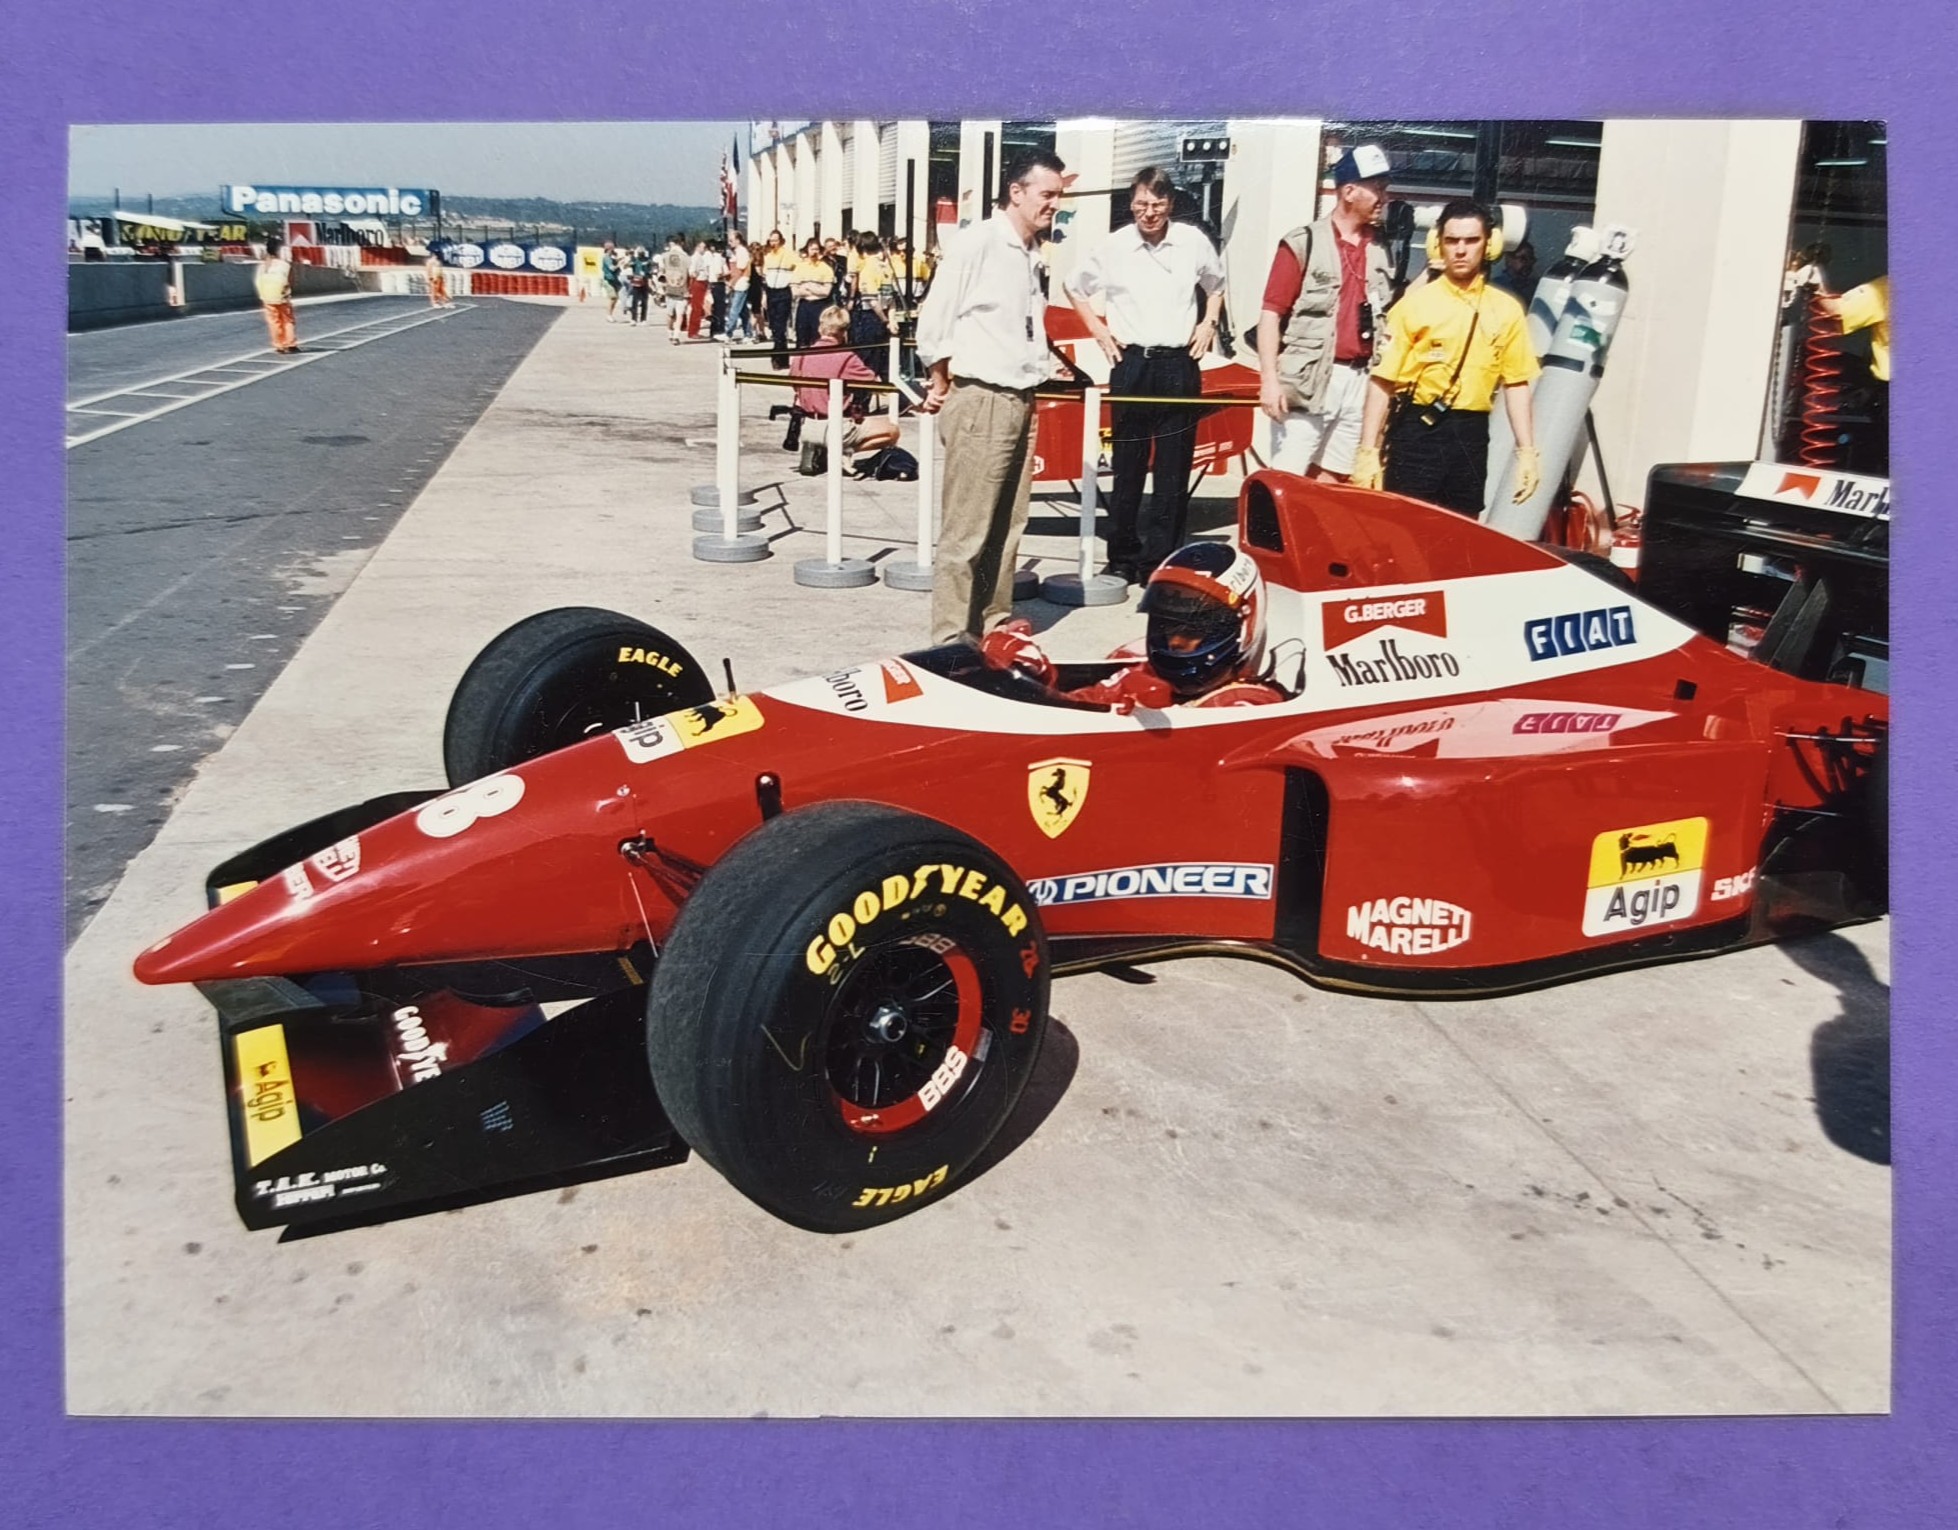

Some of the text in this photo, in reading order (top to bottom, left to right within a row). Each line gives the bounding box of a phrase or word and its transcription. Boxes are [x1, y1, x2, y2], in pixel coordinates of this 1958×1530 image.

[231, 185, 422, 216] Panasonic
[1344, 599, 1426, 624] G.BERGER
[1527, 608, 1634, 659] FIAT
[618, 647, 683, 677] EAGLE
[1326, 639, 1460, 688] Marlboro
[416, 774, 526, 839] 8
[1063, 866, 1268, 900] PIONEER
[1603, 879, 1680, 925] Agip
[806, 864, 1028, 974] GOODYEAR
[393, 1005, 449, 1083] GOODYE
[247, 1079, 295, 1122] Agip
[917, 1045, 968, 1112] BBS
[852, 1164, 949, 1207] EAGLE
